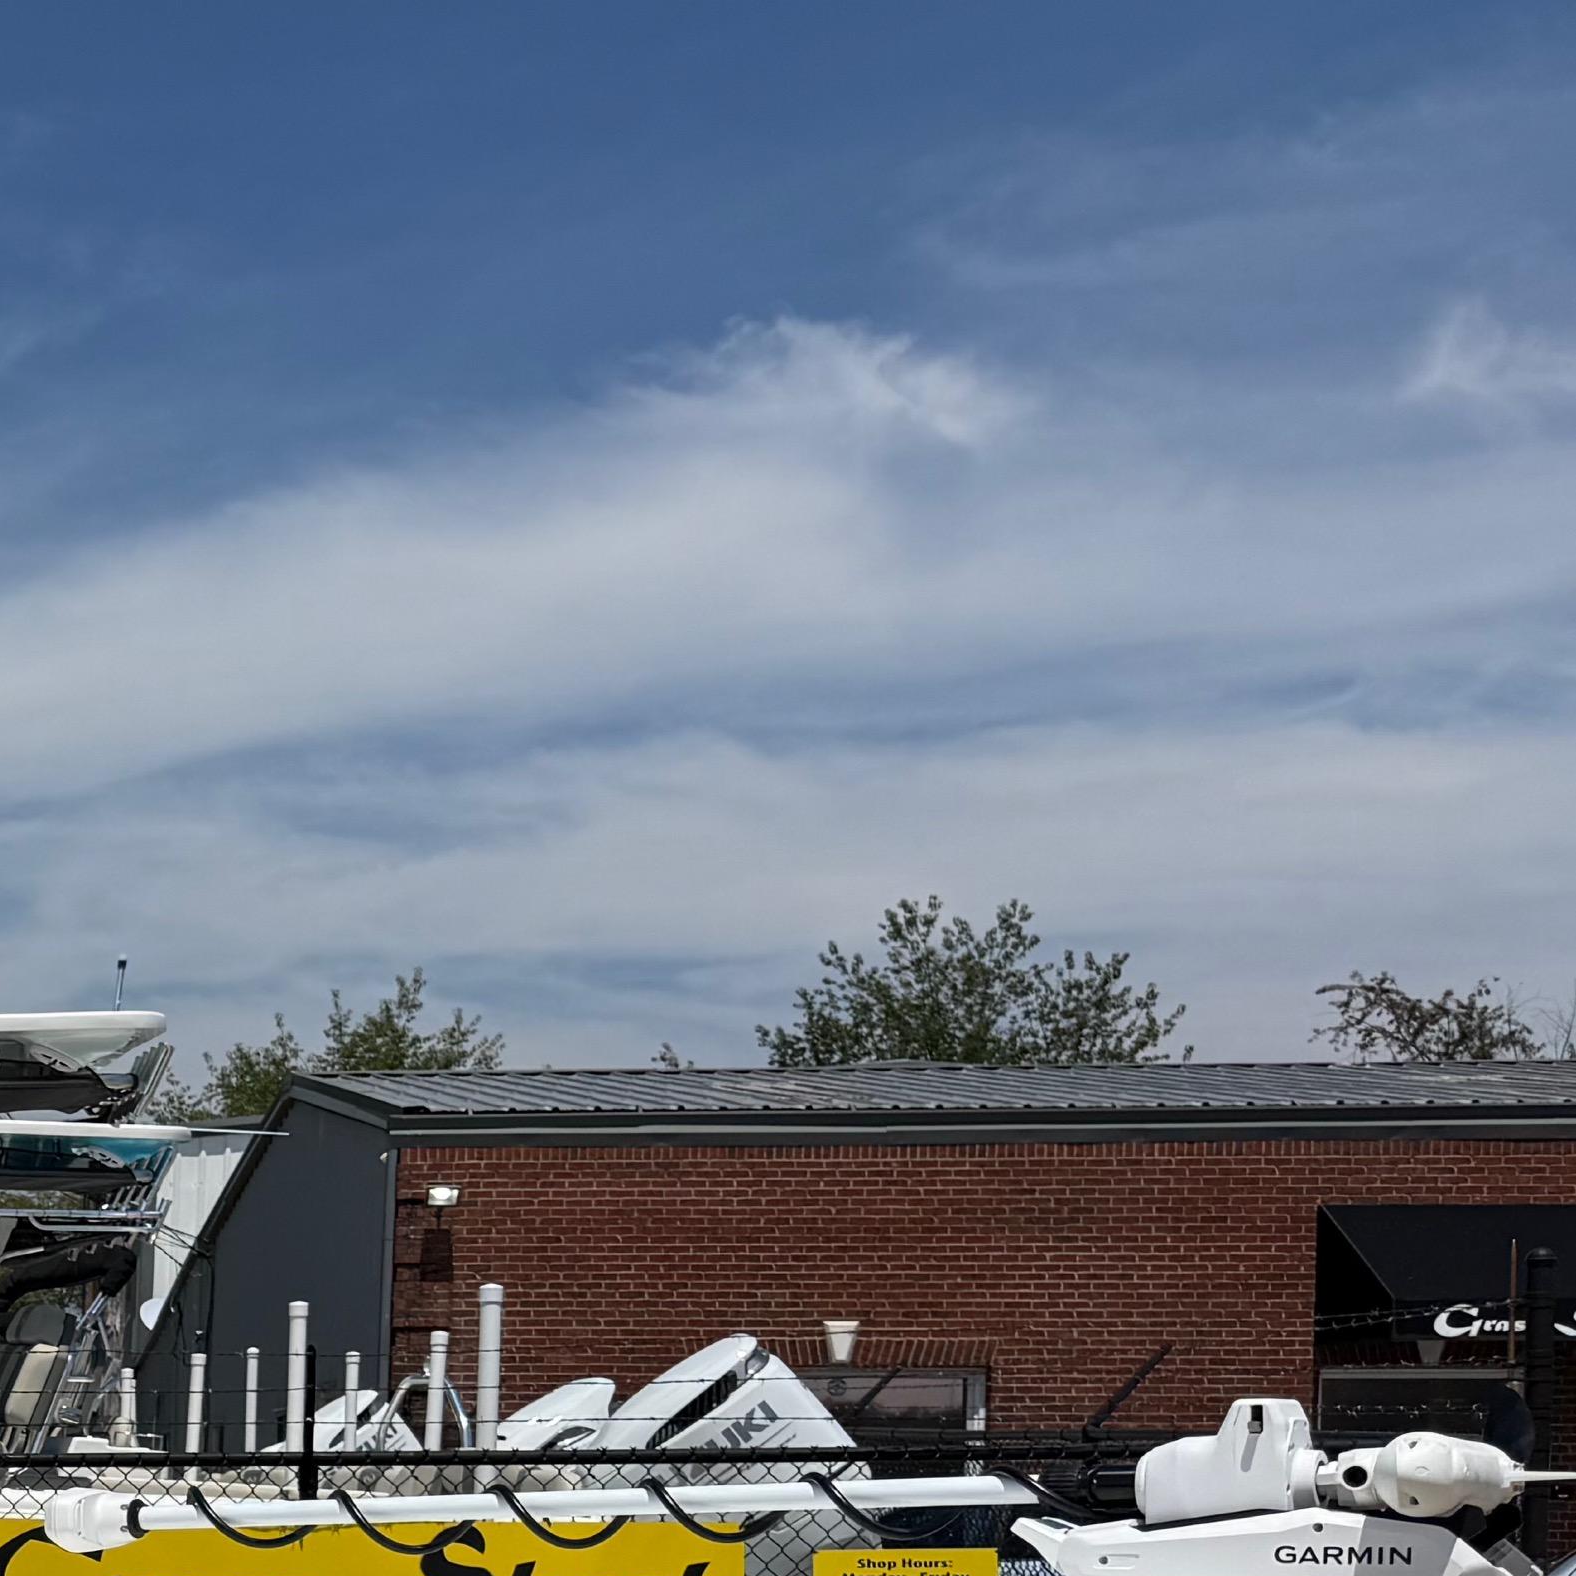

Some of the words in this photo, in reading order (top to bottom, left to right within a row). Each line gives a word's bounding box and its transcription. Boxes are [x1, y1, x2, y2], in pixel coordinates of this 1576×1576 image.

[1433, 1303, 1528, 1338] Gras
[857, 1558, 897, 1570] Shop
[901, 1558, 953, 1569] Hours:
[1274, 1545, 1413, 1566] GARMIN
